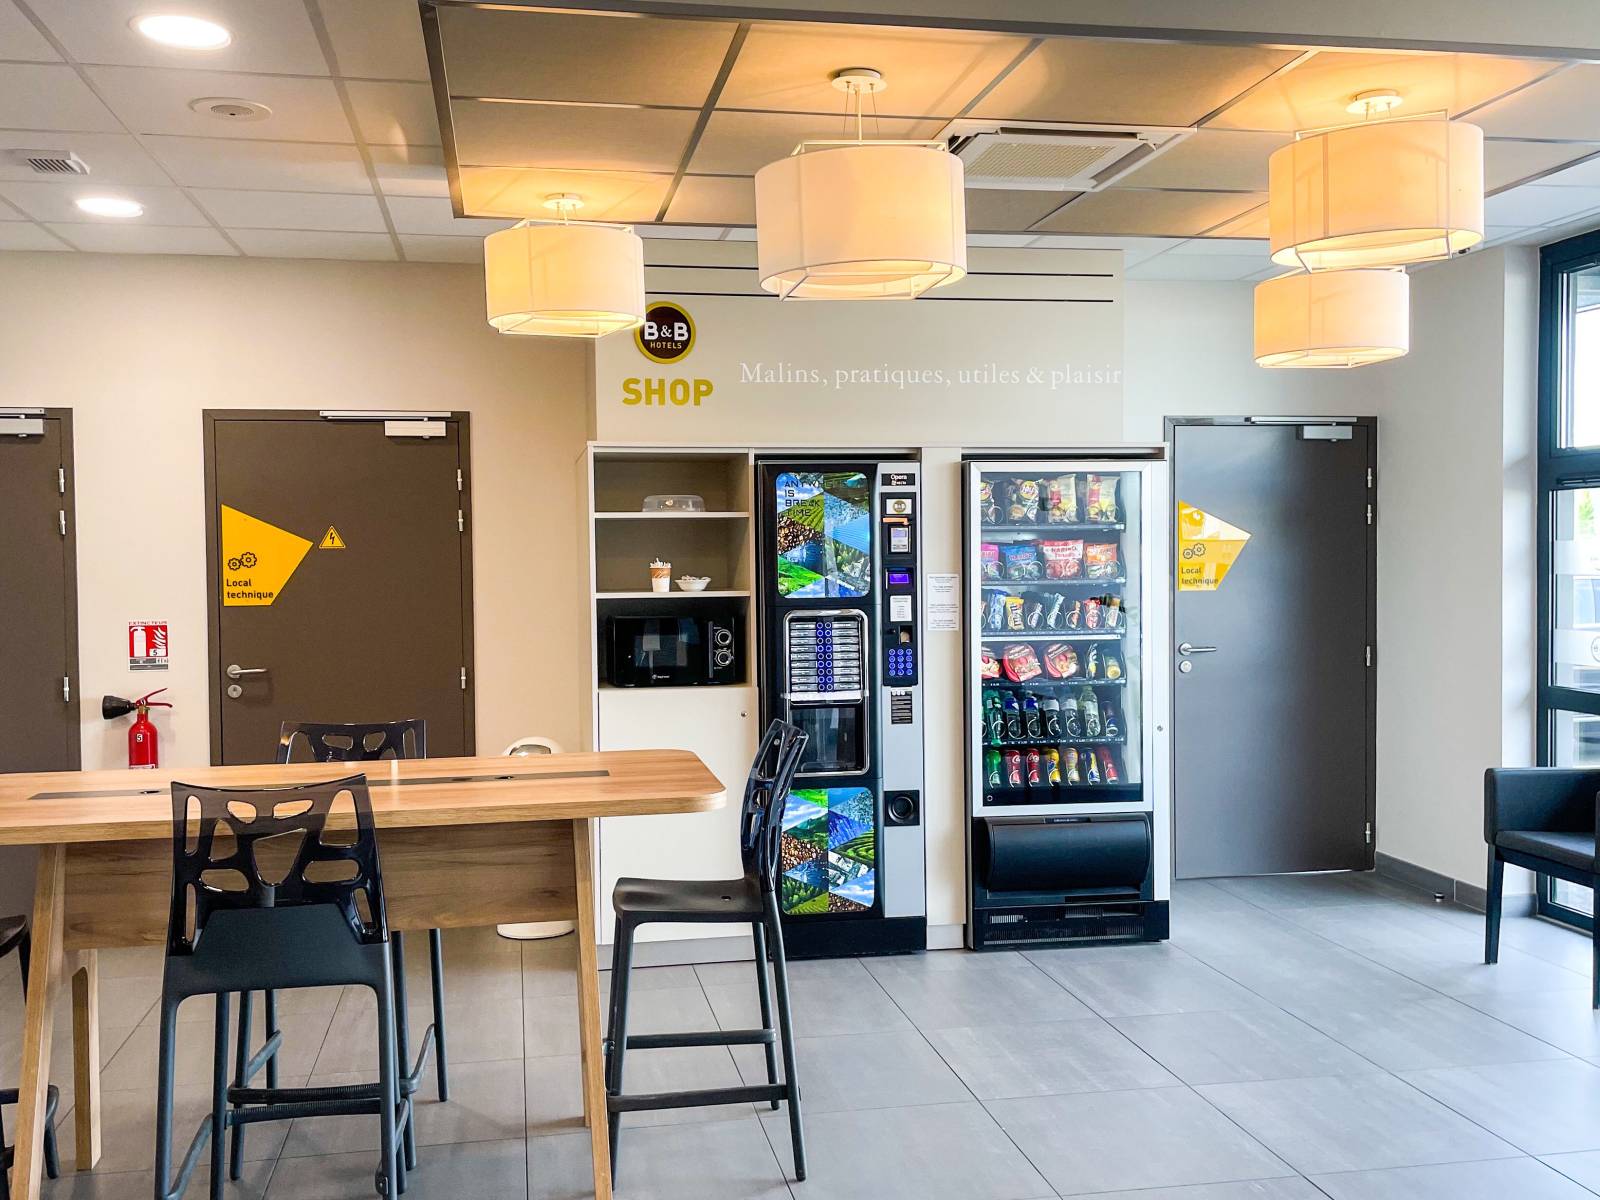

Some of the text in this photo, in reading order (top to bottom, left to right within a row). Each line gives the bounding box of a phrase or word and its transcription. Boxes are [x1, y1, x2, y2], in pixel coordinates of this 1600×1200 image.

[644, 321, 689, 341] B&B
[739, 362, 1122, 390] Malins, pratiques, utiles & plaisir
[622, 377, 714, 406] SHOP
[784, 489, 795, 498] IS
[785, 499, 820, 507] BREAK
[786, 509, 811, 517] TIME
[226, 578, 252, 587] Local
[1181, 578, 1219, 586] technique
[227, 590, 274, 600] technique
